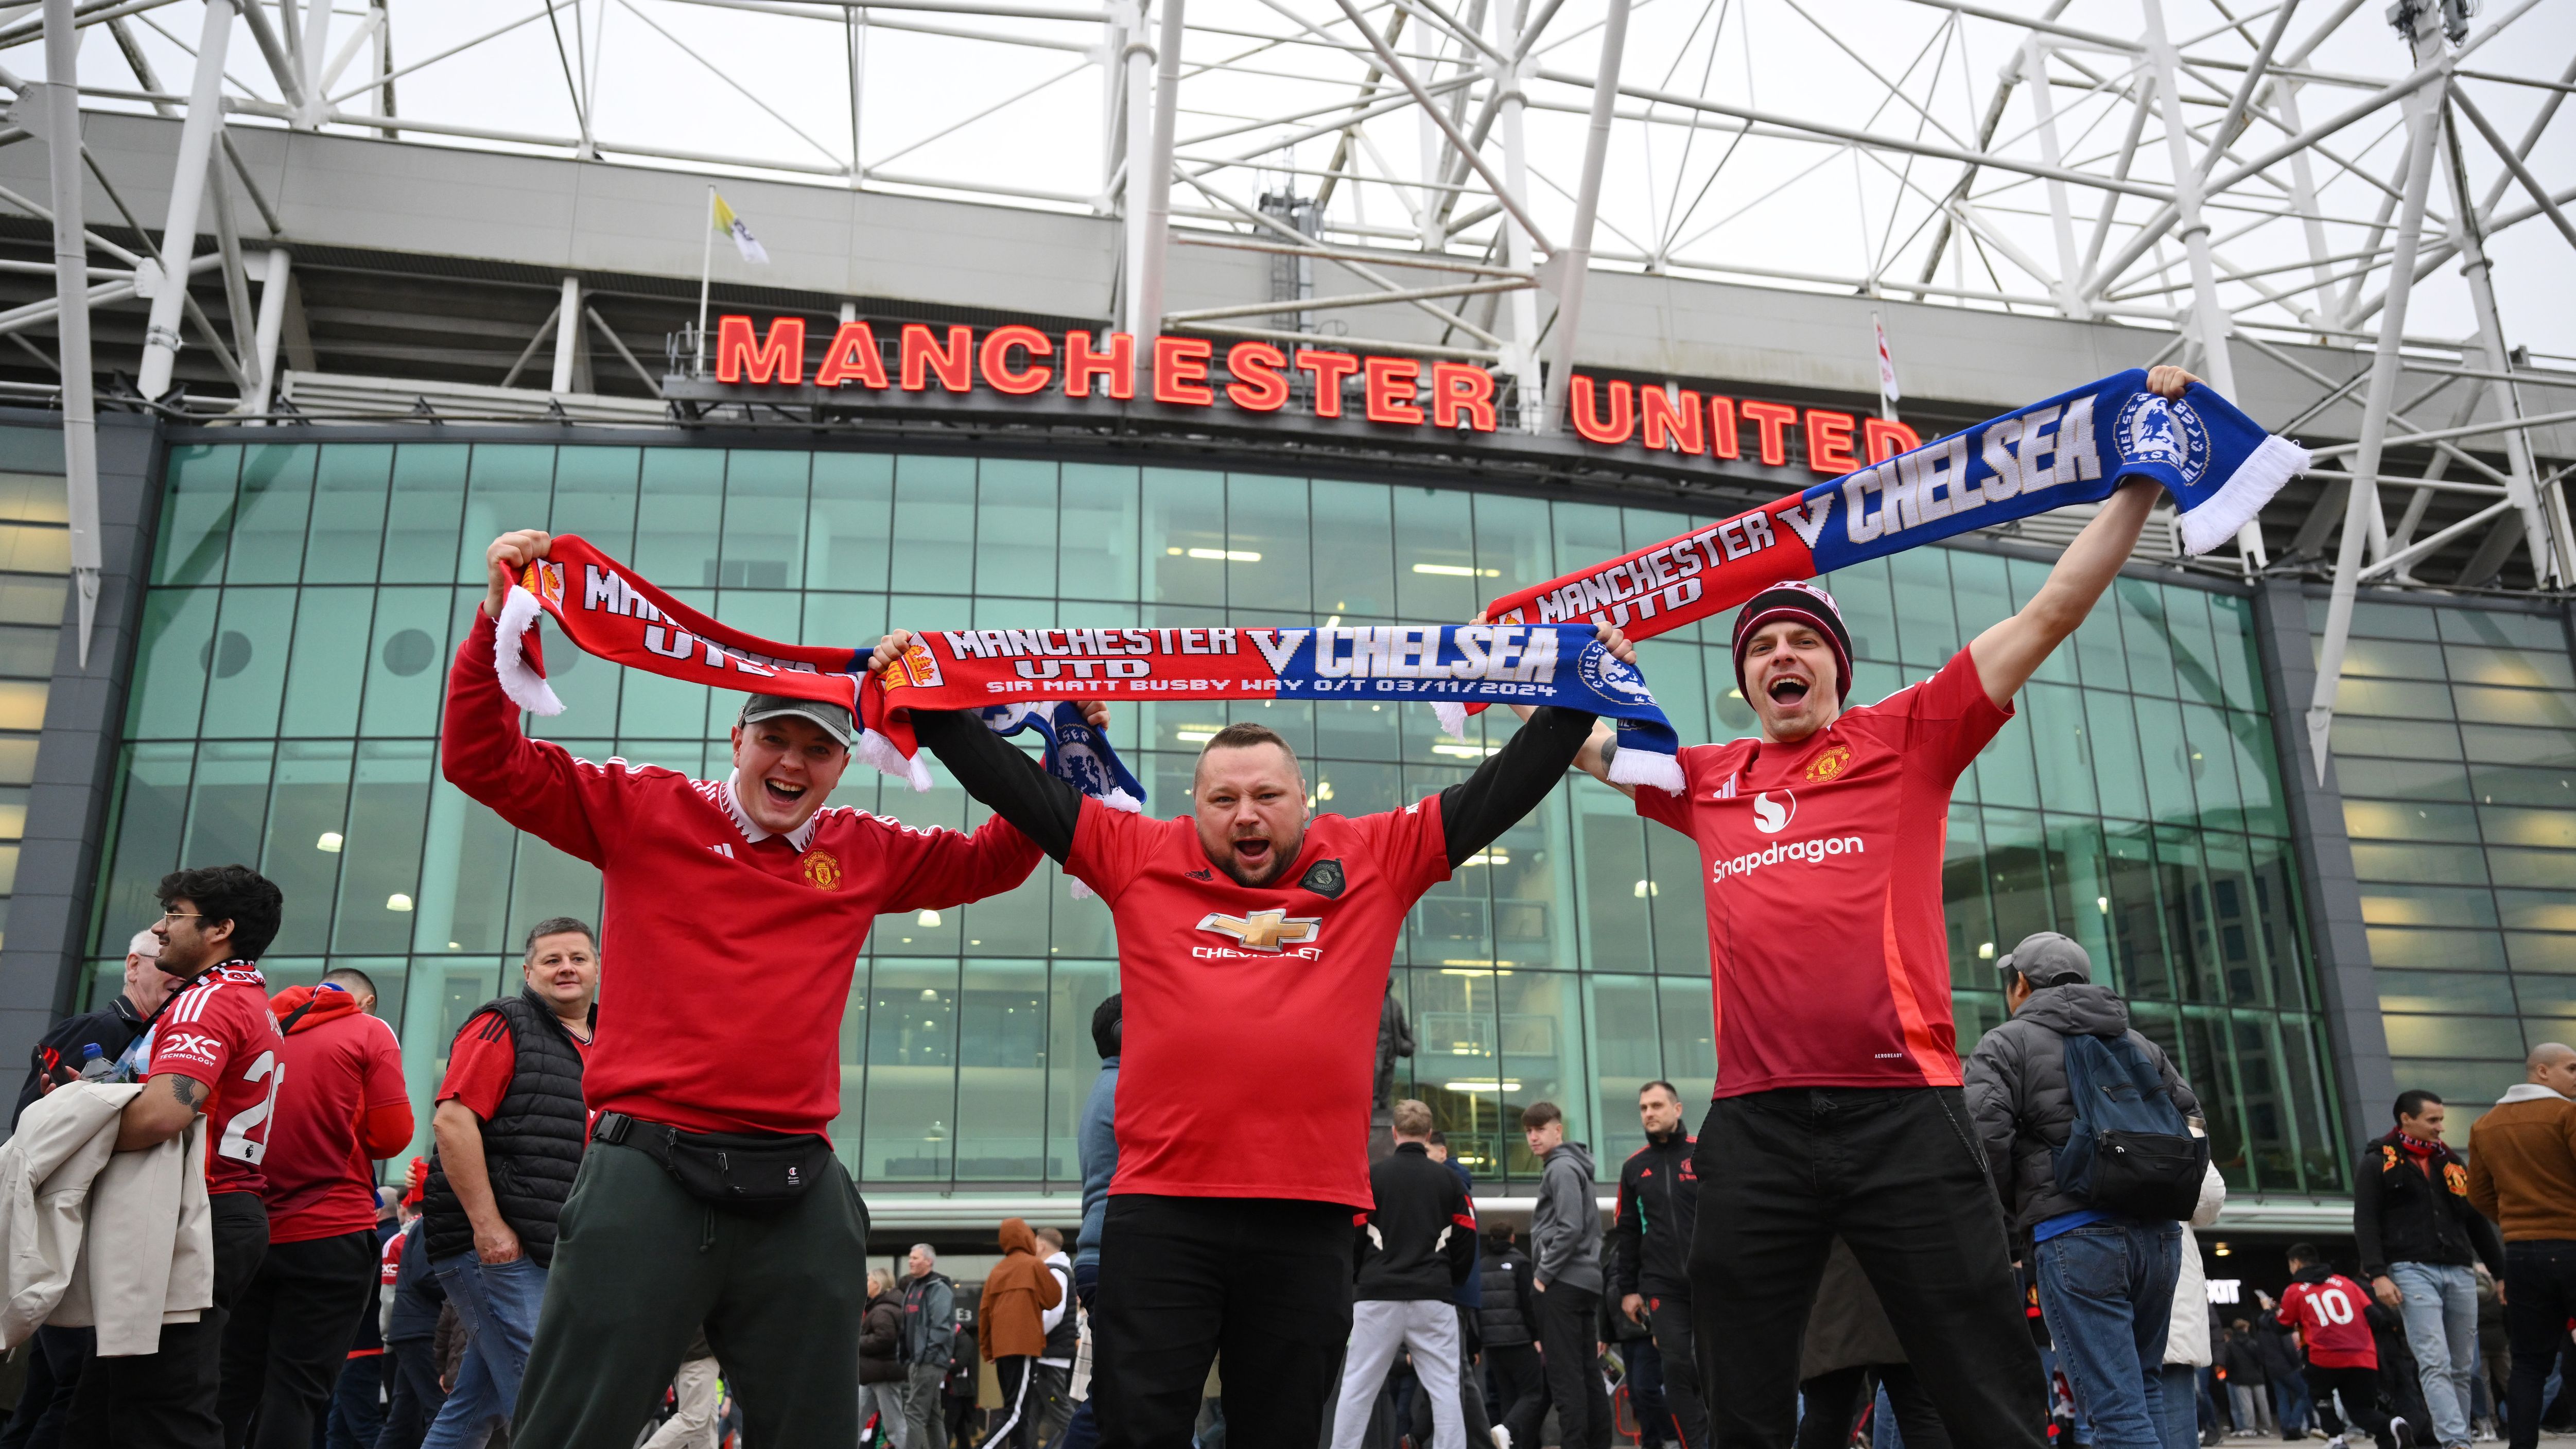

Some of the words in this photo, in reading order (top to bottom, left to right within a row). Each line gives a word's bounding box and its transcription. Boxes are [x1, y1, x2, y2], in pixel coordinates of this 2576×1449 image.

[716, 315, 1497, 431] MANCHESTER
[1570, 375, 1922, 473] UNITED
[2119, 393, 2151, 456] HELSEA
[2173, 403, 2204, 452] CLUB
[1536, 510, 1776, 623] MANCHESTER
[1777, 492, 1836, 549] V
[1841, 394, 2102, 545] CHELSEA
[1590, 577, 1703, 630] UTD
[942, 627, 1238, 659] MANCHESTER
[1245, 630, 1309, 675] V
[1315, 626, 1558, 684] CHELSEA
[1013, 658, 1151, 679] UTD
[986, 680, 1033, 693] SIR
[1043, 680, 1119, 691] MATT
[1129, 679, 1230, 691] BUSBY
[1241, 679, 1304, 691] WAY
[1376, 679, 1557, 697] 03/11/2024
[1818, 766, 1842, 781] UNITED
[807, 854, 835, 868] MANCHESTER
[1713, 836, 1864, 883] Snapdragon
[160, 1053, 214, 1067] TECHNOLOGY
[162, 1034, 222, 1061] DXC
[2205, 1279, 2241, 1304] XIT
[2305, 1288, 2354, 1327] 10
